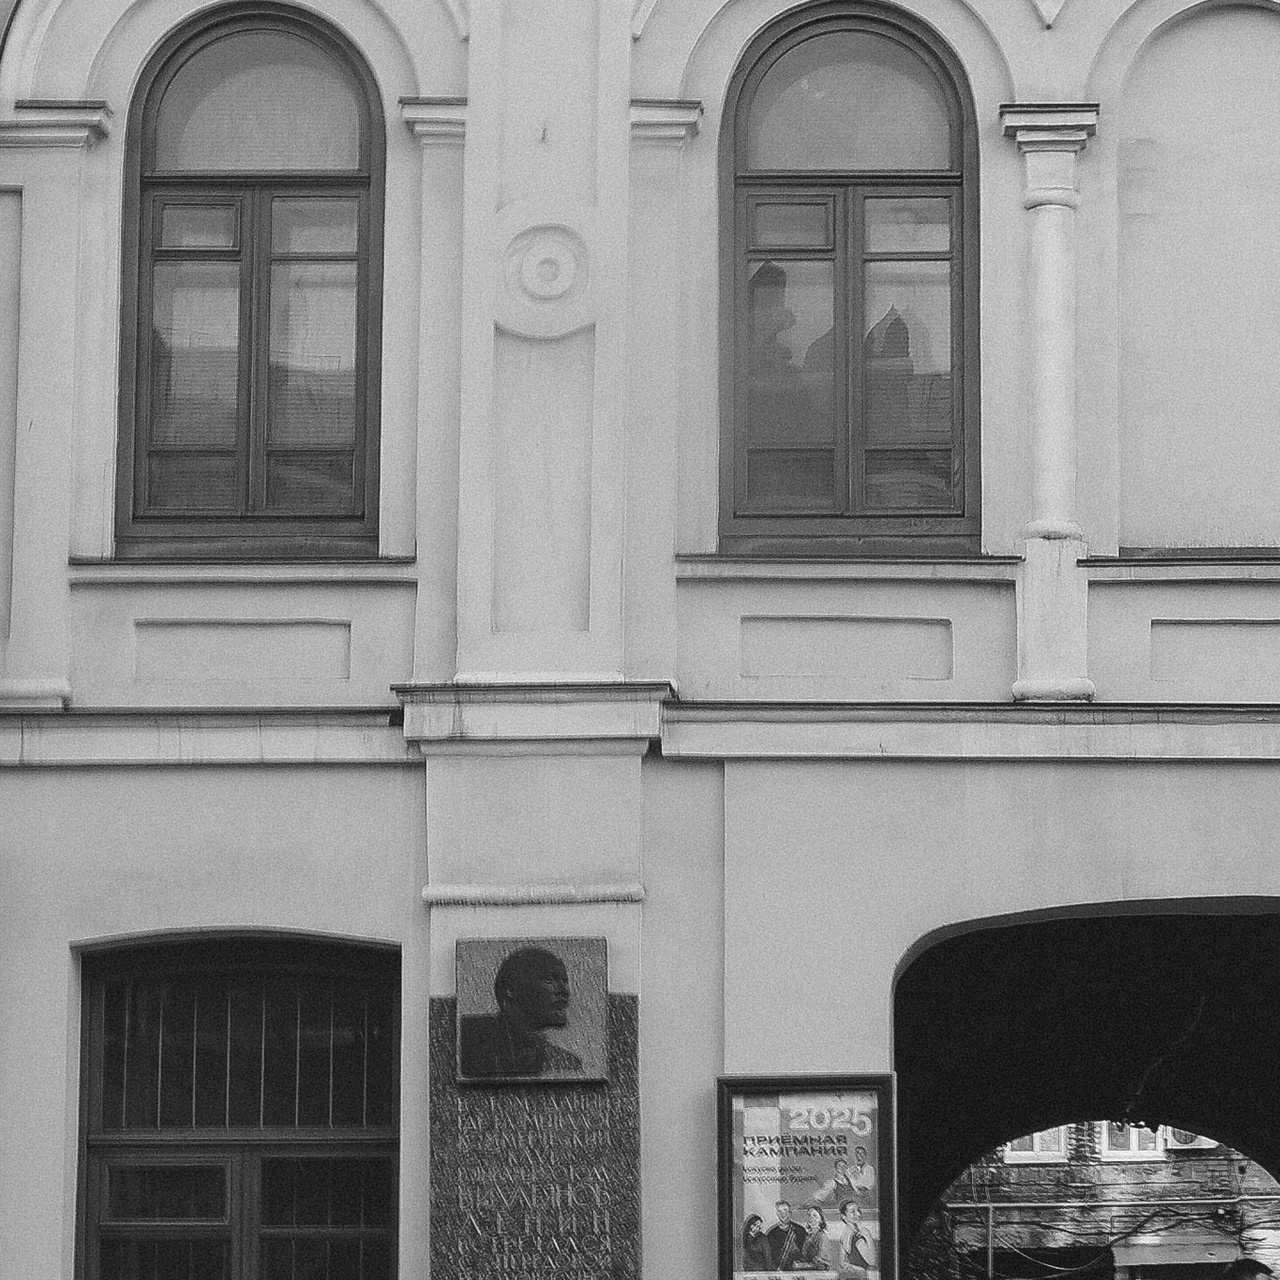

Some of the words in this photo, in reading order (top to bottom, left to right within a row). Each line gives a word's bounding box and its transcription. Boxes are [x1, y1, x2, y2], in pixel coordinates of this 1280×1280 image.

[788, 1108, 872, 1137] 2025
[743, 1133, 848, 1146] ПРИЁМНАЯ
[743, 1146, 848, 1158] КАМПАНИЯ
